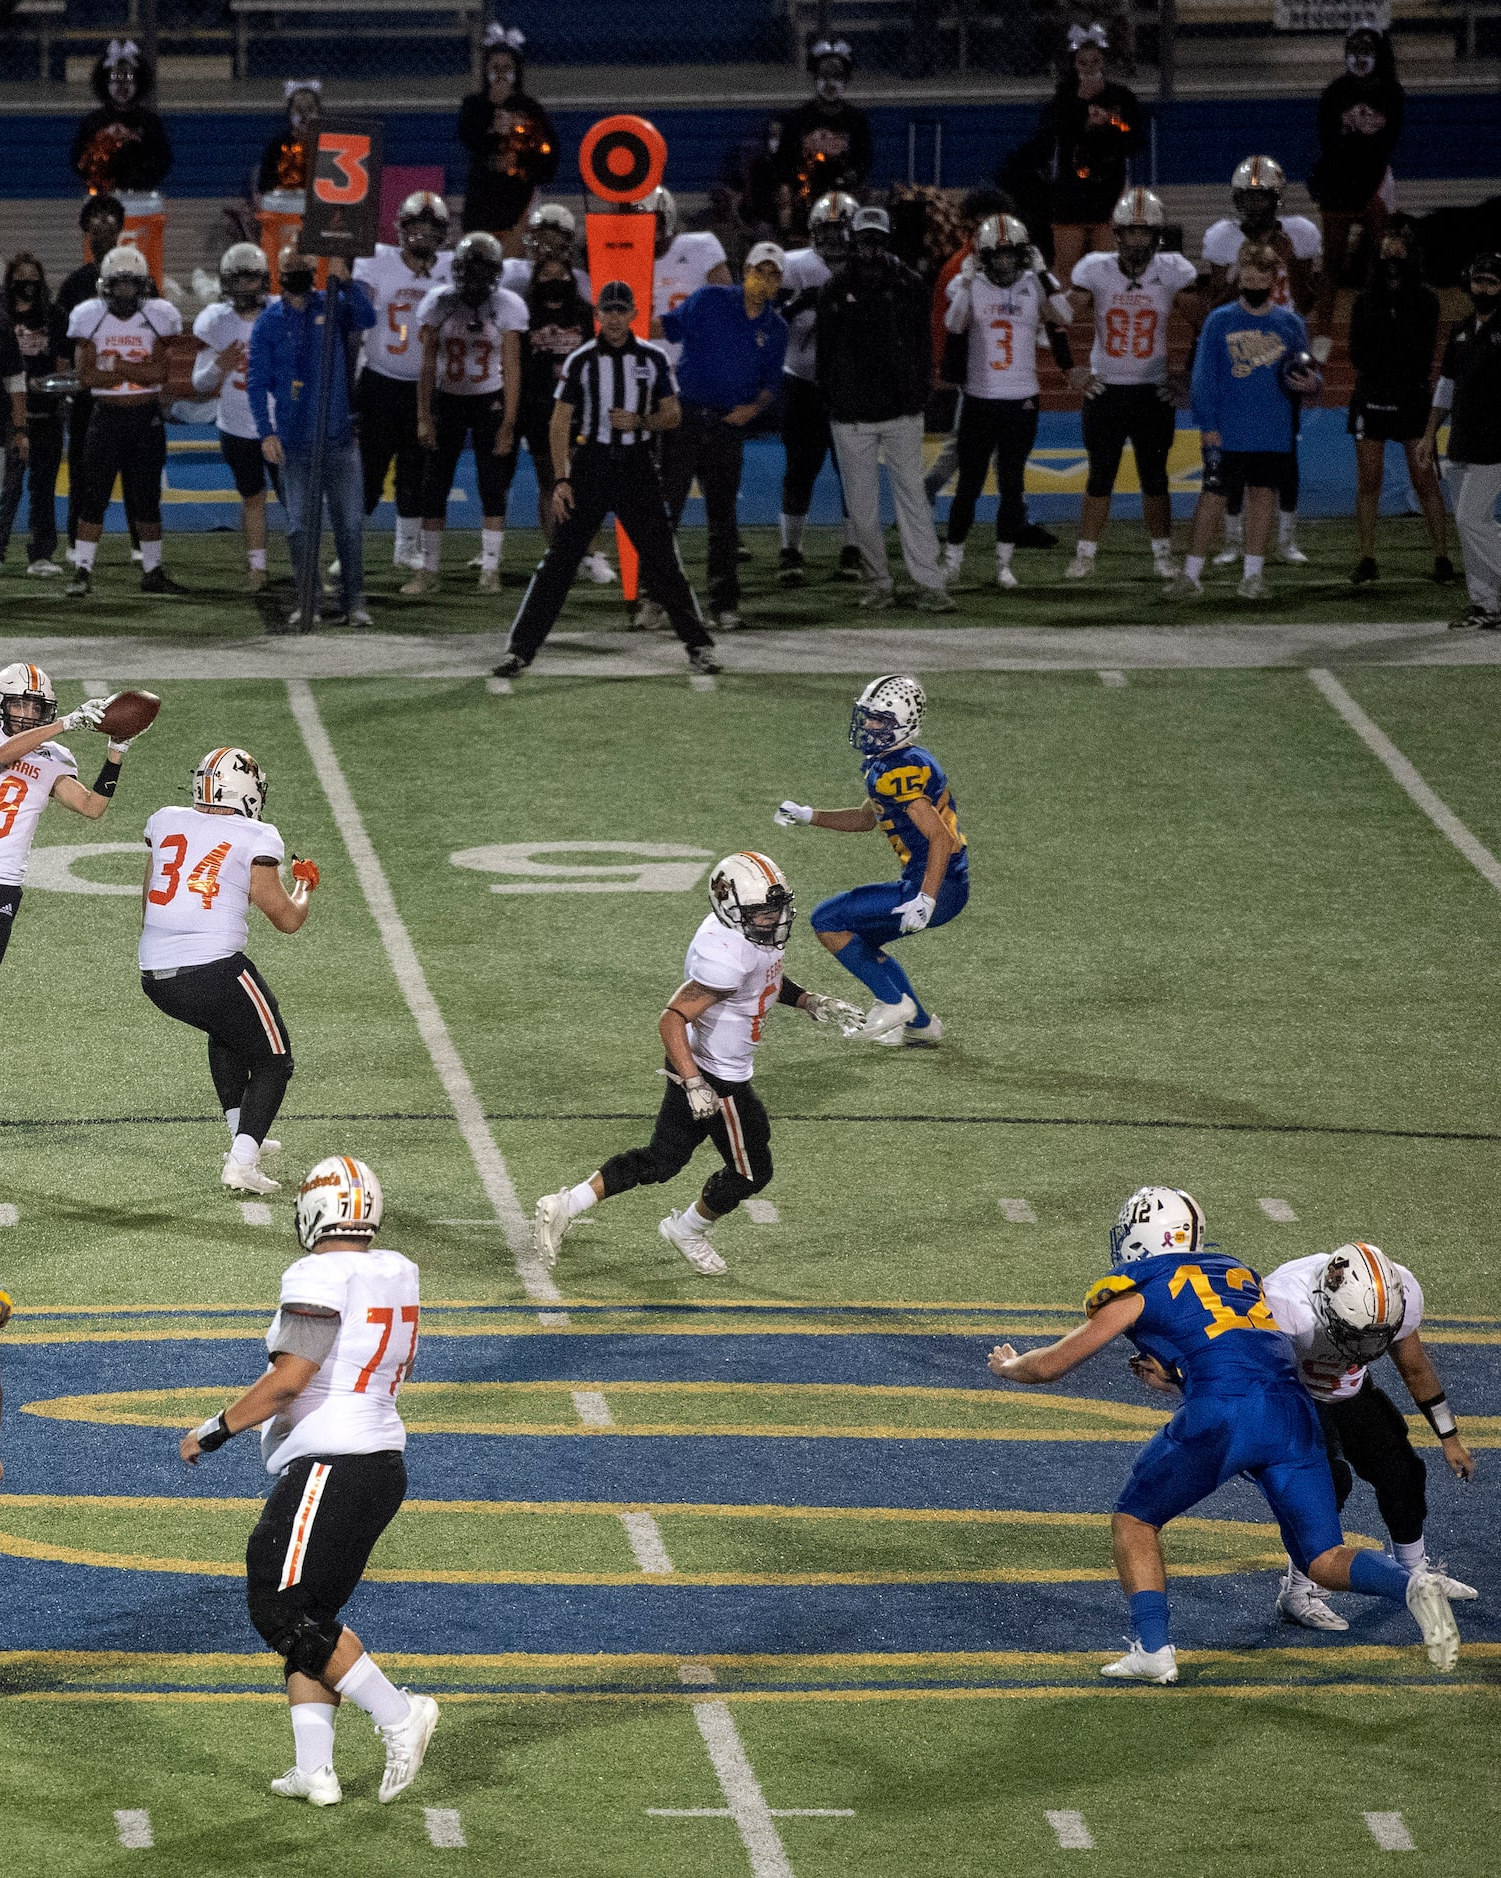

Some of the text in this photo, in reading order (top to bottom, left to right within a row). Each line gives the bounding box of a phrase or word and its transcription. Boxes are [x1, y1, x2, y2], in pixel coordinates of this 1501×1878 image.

[313, 133, 371, 205] 3
[989, 320, 1013, 371] 3
[1106, 309, 1158, 358] 88
[445, 338, 493, 383] 83
[889, 773, 923, 796] 15
[148, 833, 233, 910] 34
[1130, 1201, 1152, 1224] 12
[1167, 1264, 1282, 1340] 12
[353, 1305, 420, 1397] 77
